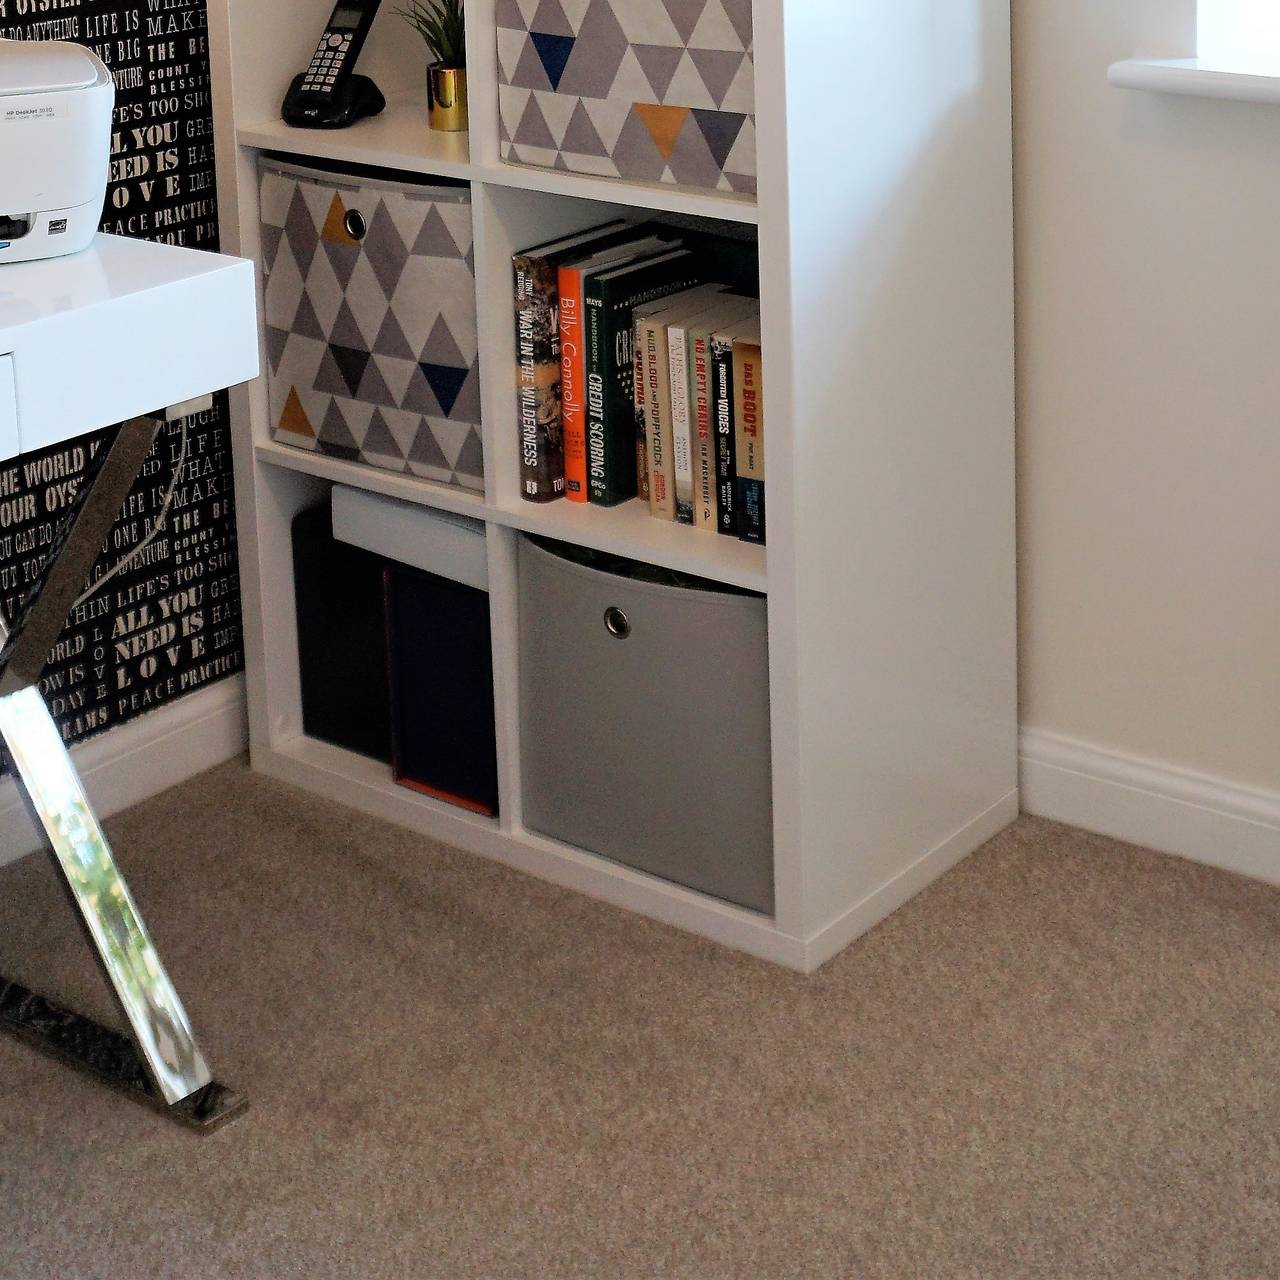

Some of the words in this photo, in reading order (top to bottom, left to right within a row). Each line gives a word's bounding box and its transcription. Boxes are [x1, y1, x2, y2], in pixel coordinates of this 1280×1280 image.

[519, 310, 533, 337] WAR
[560, 297, 576, 336] Billy
[521, 342, 533, 356] IN
[521, 358, 534, 381] THE
[561, 342, 580, 424] Connolly
[587, 373, 604, 421] CREDIT
[696, 357, 707, 395] EMPTY
[522, 386, 537, 467] WILDERNESS
[718, 399, 730, 434] VOICES
[744, 389, 756, 437] BOOT
[589, 422, 607, 478] SCORING
[111, 606, 154, 640] ALL
[158, 584, 204, 620] YOU
[114, 621, 177, 665] NEED
[181, 610, 205, 636] IS
[116, 636, 206, 689] LOVE
